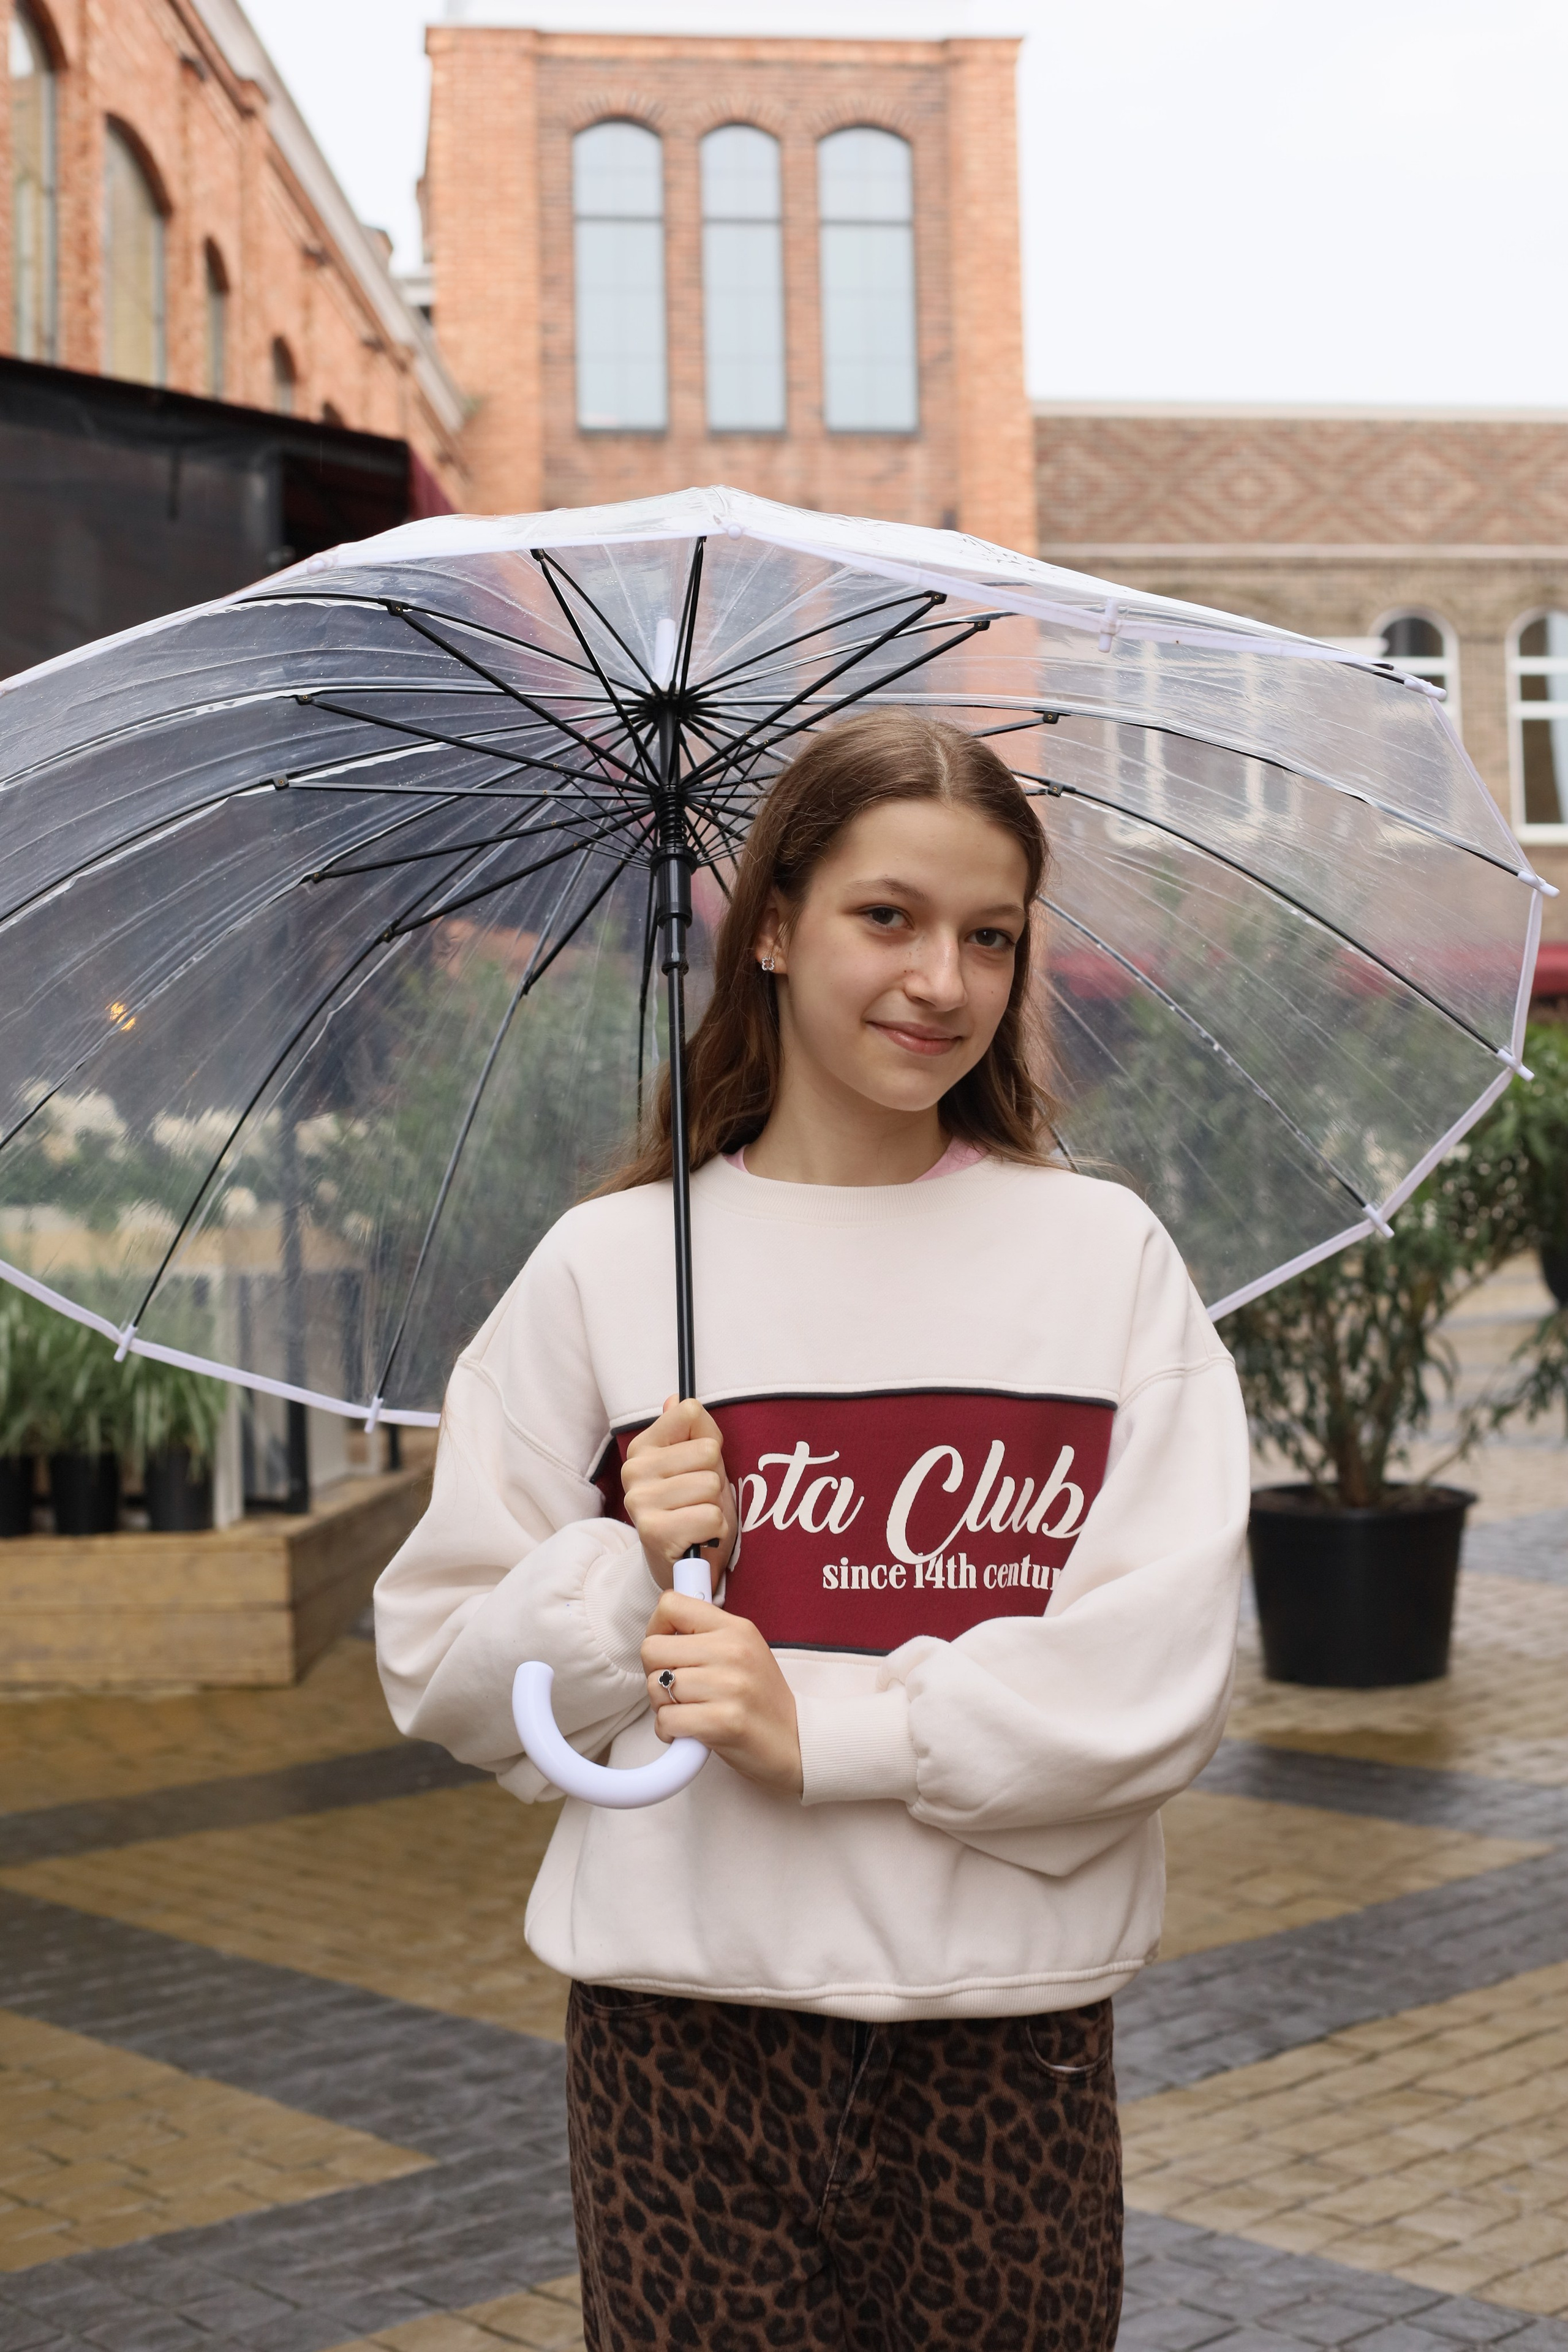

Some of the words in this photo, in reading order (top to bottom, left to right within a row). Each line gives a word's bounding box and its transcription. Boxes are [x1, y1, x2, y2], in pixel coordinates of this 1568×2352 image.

[886, 1439, 1085, 1564] Club
[823, 1556, 907, 1589] since
[913, 1553, 977, 1589] 14th
